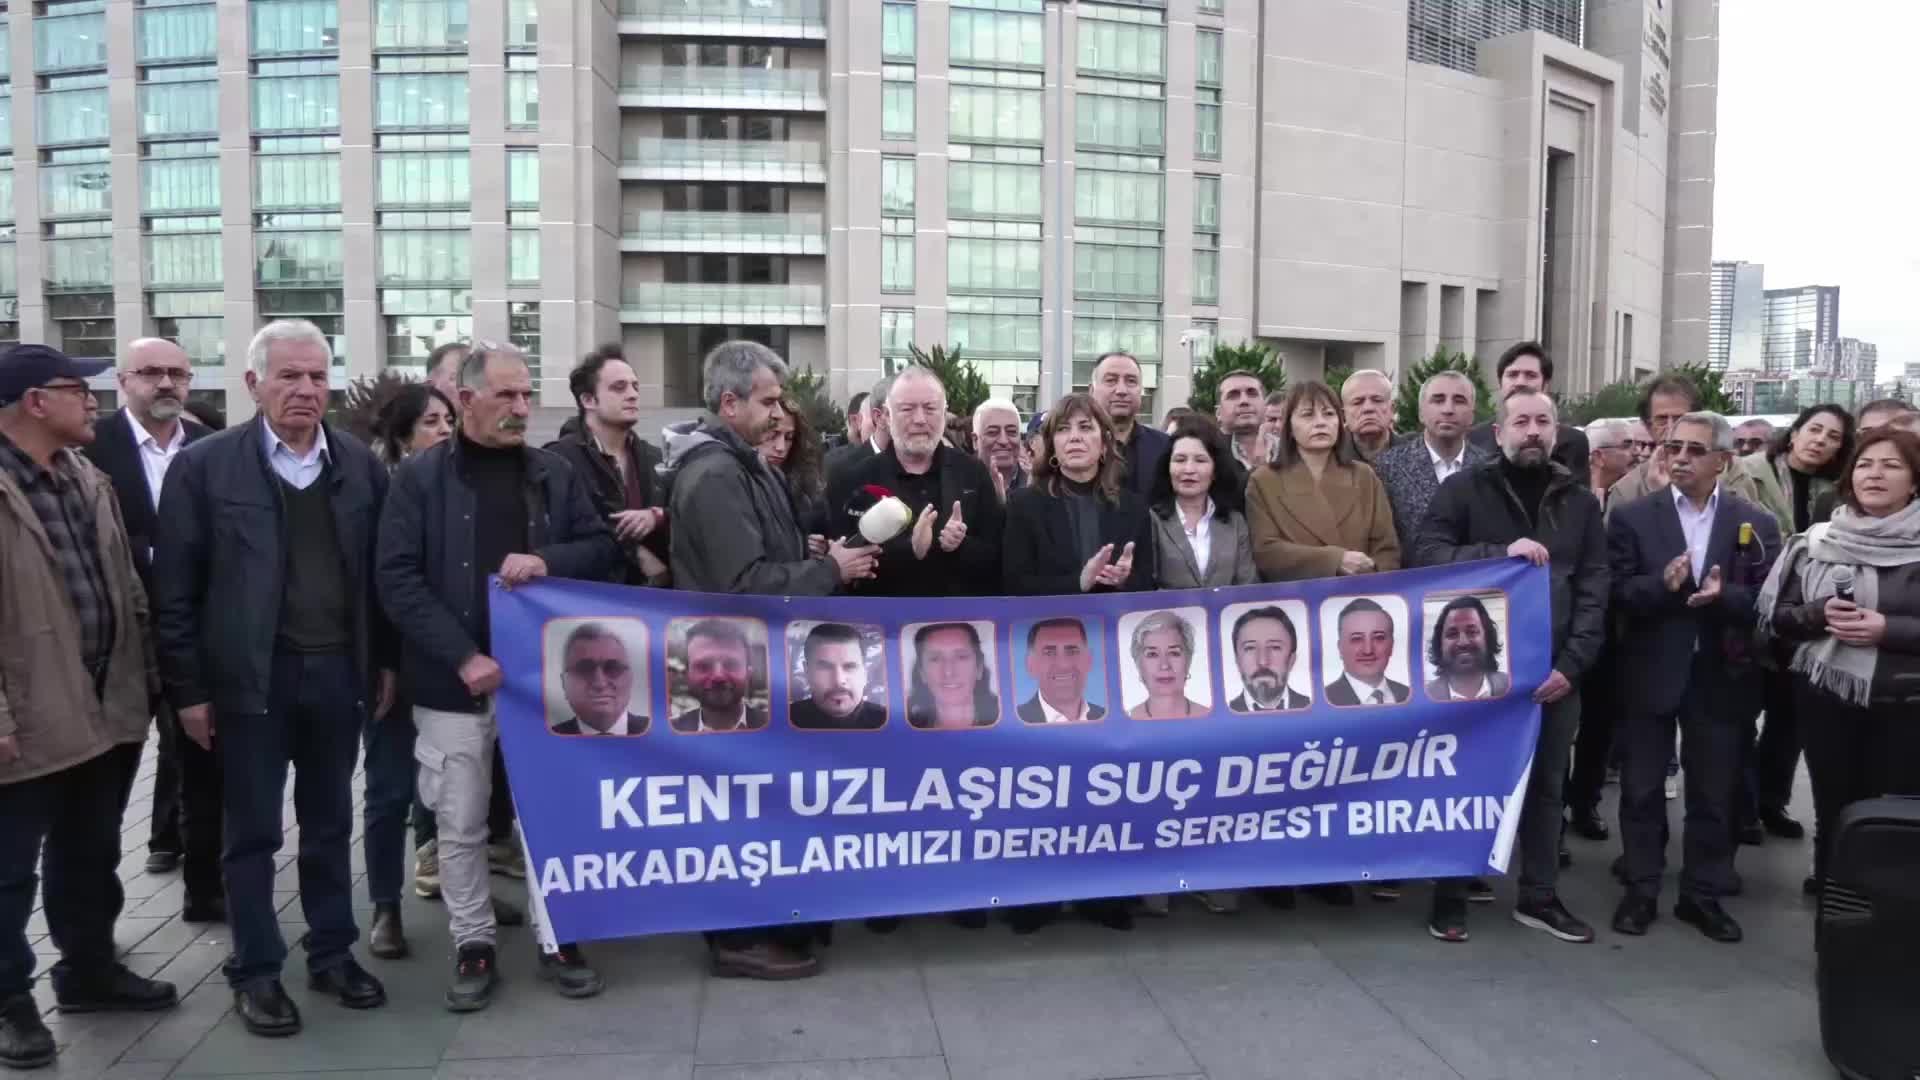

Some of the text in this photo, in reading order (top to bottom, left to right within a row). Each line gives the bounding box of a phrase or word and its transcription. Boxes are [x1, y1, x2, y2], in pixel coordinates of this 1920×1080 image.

[599, 729, 1458, 830] KENT UZLAŞISI SUÇ DEĞİLDİR
[541, 829, 962, 897] ARKADAŞLARIMIZI
[973, 822, 1144, 860] DERHAL
[1154, 802, 1338, 849] SERBEST
